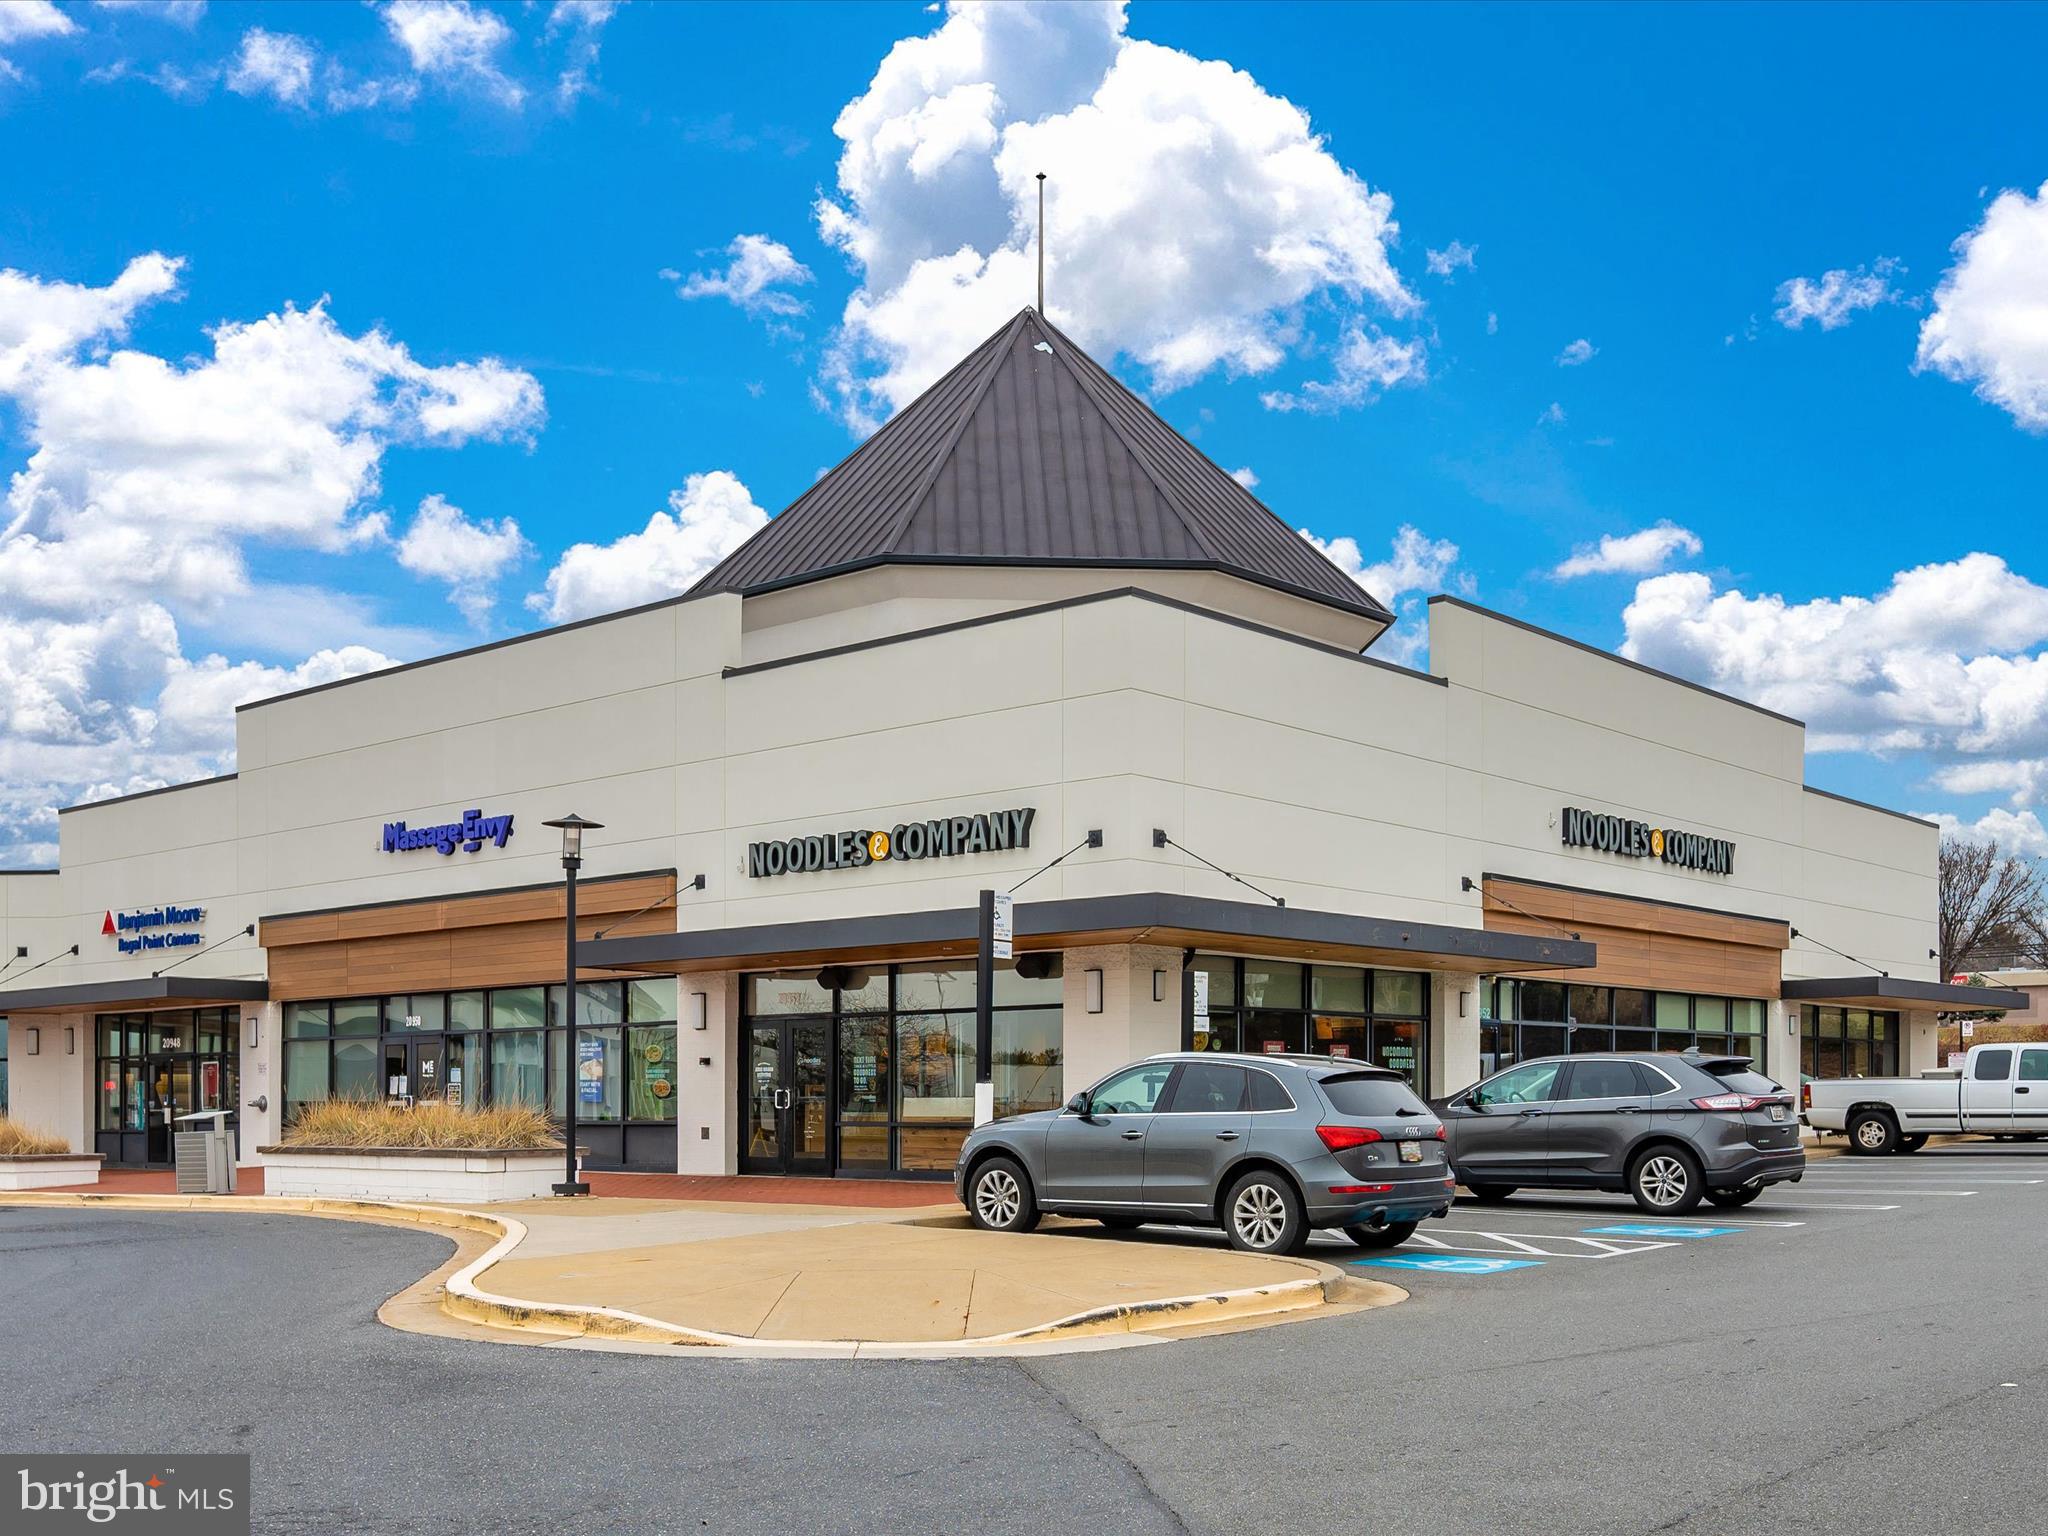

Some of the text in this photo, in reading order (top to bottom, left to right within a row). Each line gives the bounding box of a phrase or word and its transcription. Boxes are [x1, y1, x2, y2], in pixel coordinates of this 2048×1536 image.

[383, 809, 514, 855] Massage Envy
[749, 830, 871, 878] NOODLES
[890, 808, 1036, 861] COMPANY
[1563, 807, 1650, 857] NOODLES
[1663, 829, 1736, 875] COMPANY
[118, 905, 200, 932] Benjamin Moore
[118, 933, 200, 954] Regal Paint Centers
[162, 1037, 181, 1049] 20948
